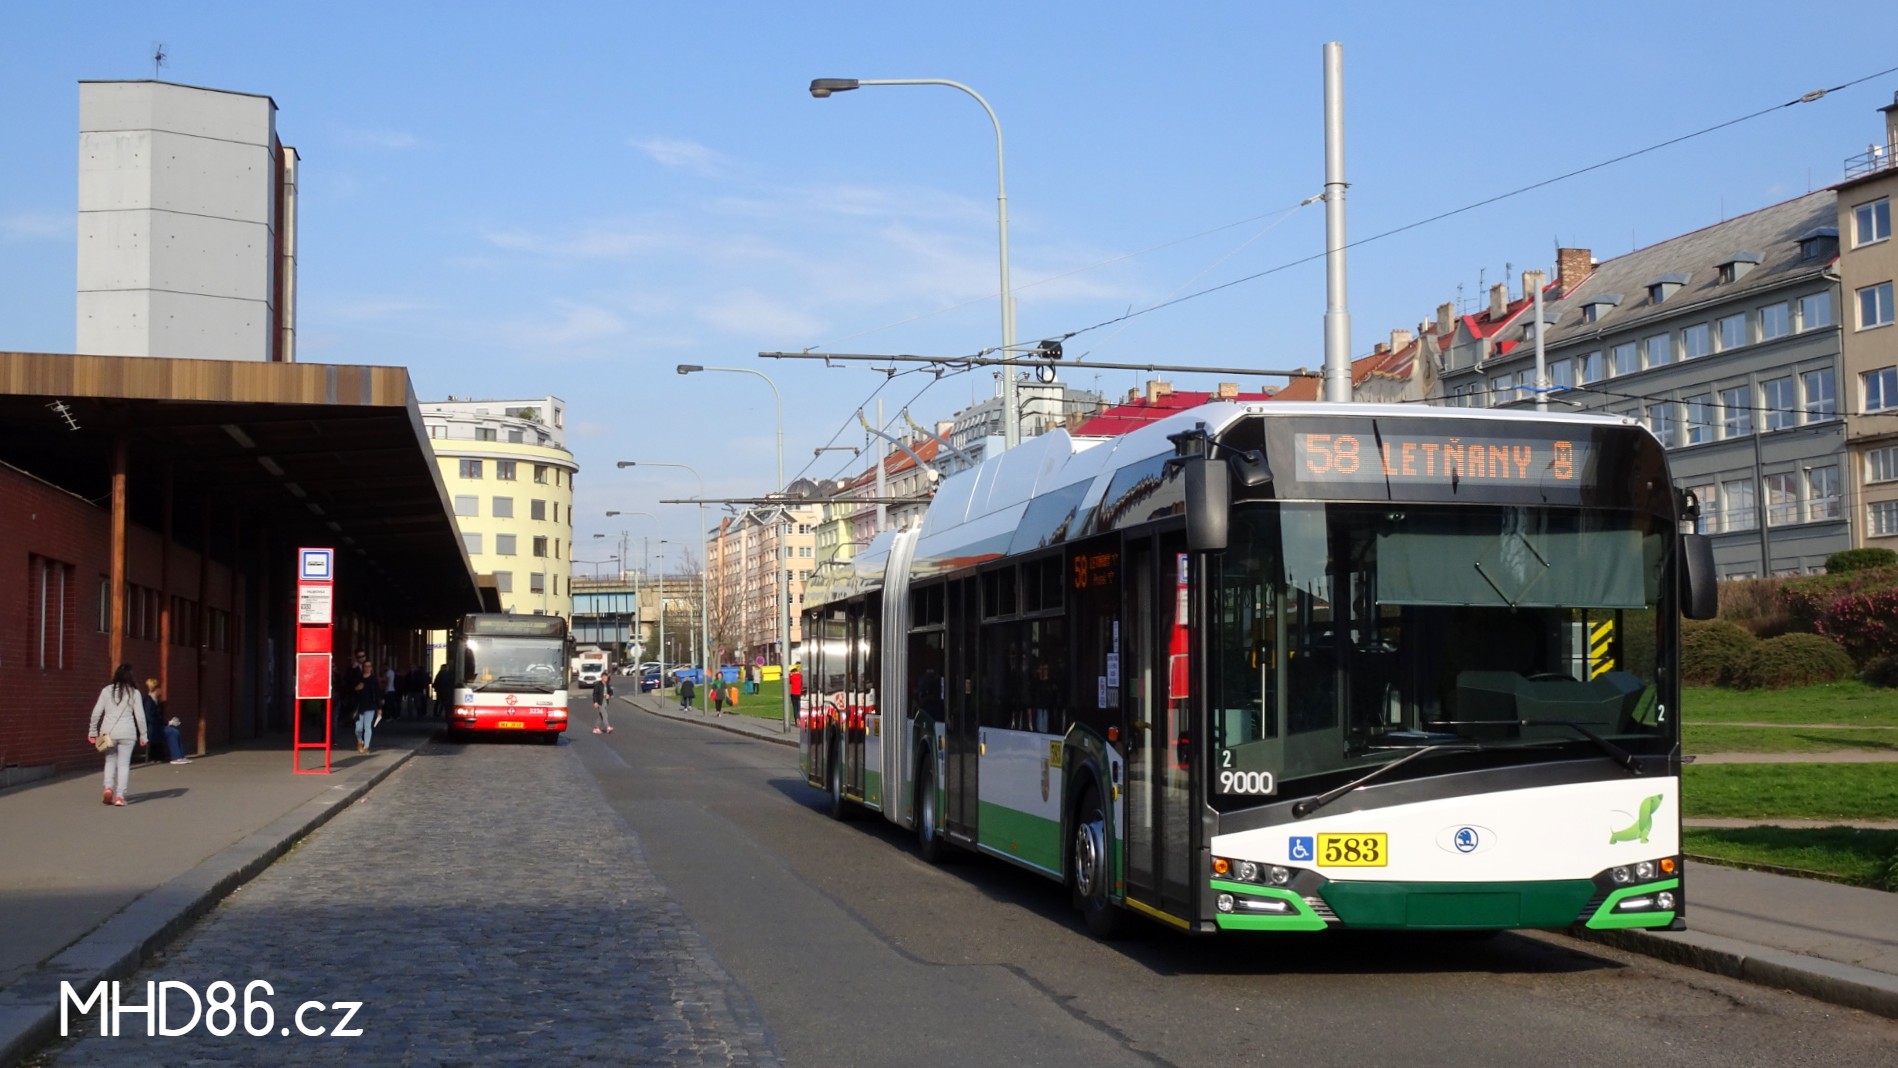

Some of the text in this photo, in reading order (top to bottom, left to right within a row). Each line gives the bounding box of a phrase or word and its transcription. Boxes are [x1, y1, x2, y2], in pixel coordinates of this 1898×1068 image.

[1306, 434, 1532, 479] 58 LETŇANY
[1658, 704, 1665, 722] 2
[1222, 750, 1231, 768] 2
[1220, 771, 1273, 794] 9000
[1325, 838, 1379, 862] 583
